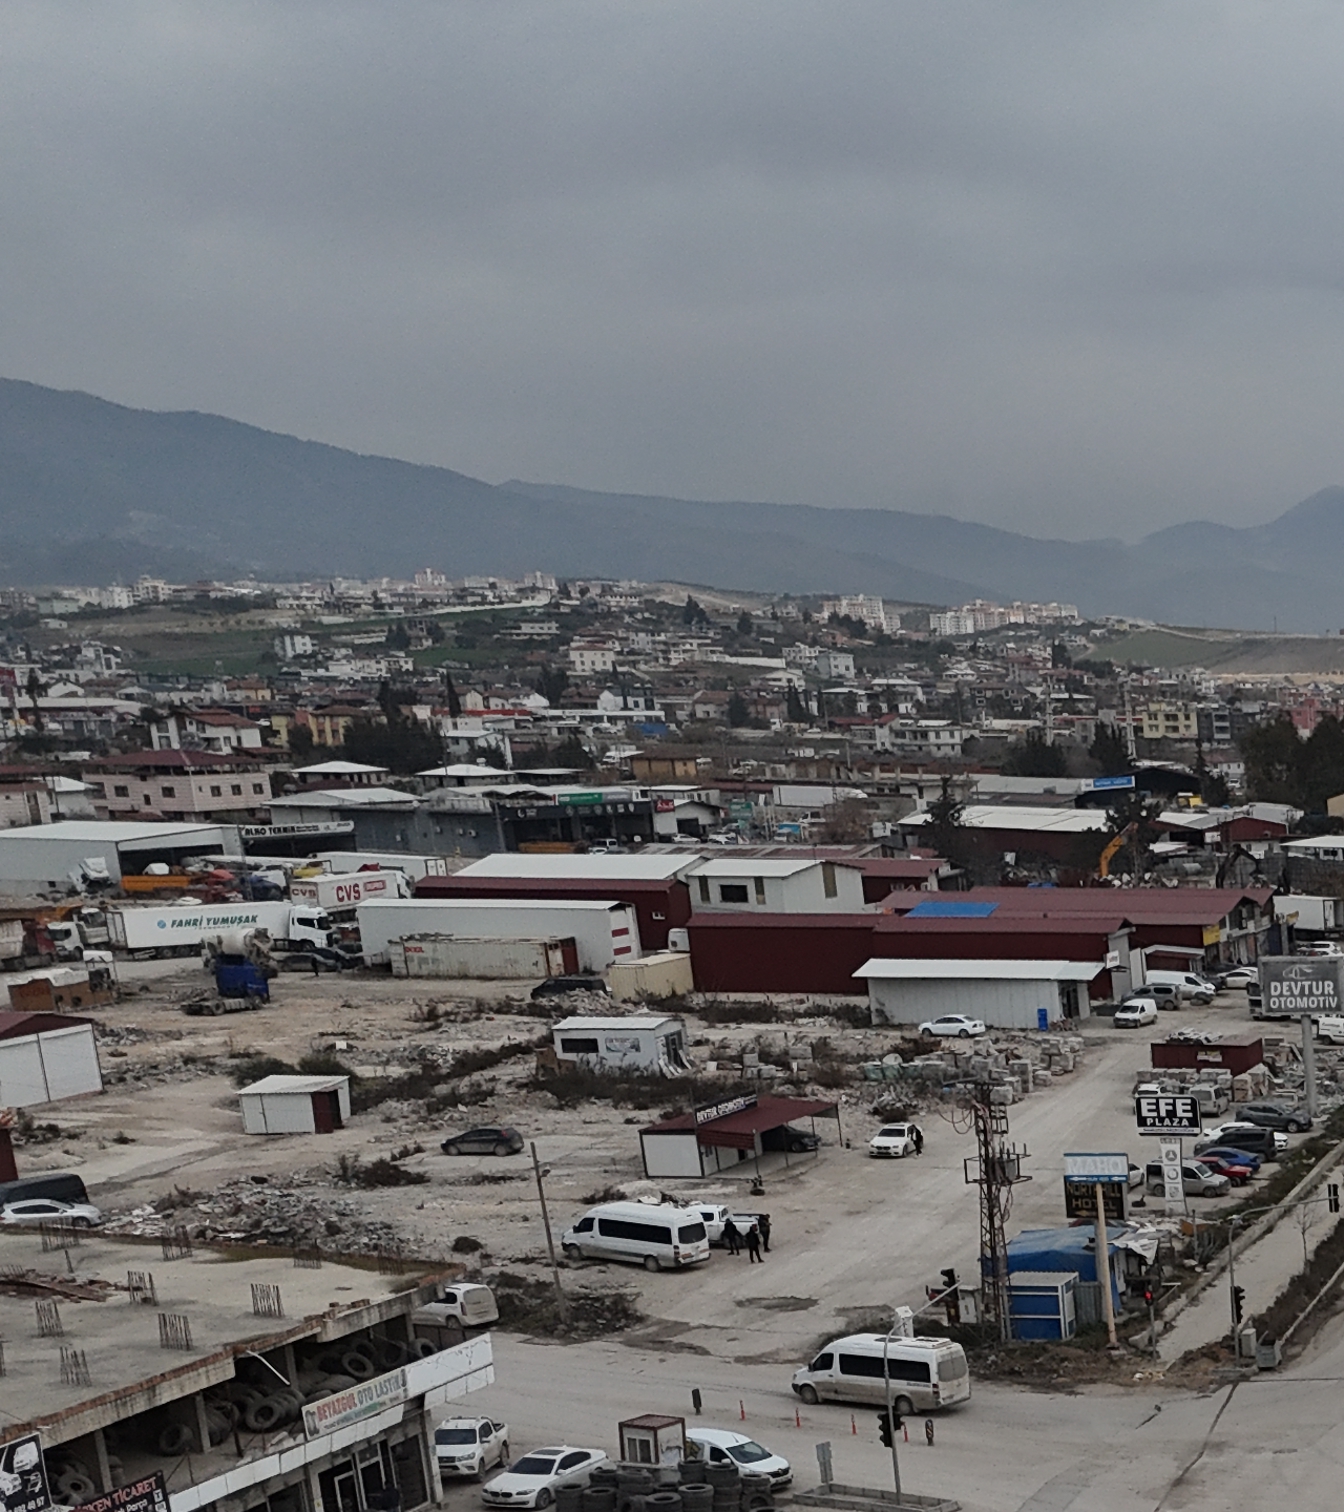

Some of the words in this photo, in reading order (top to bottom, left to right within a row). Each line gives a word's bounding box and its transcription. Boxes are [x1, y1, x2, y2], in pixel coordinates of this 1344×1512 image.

[336, 884, 360, 902] CVS
[1271, 981, 1334, 996] DEVTUR
[1270, 996, 1337, 1010] OTOMOTİV
[1141, 1098, 1193, 1117] EFE
[1146, 1118, 1189, 1126] PLAZA
